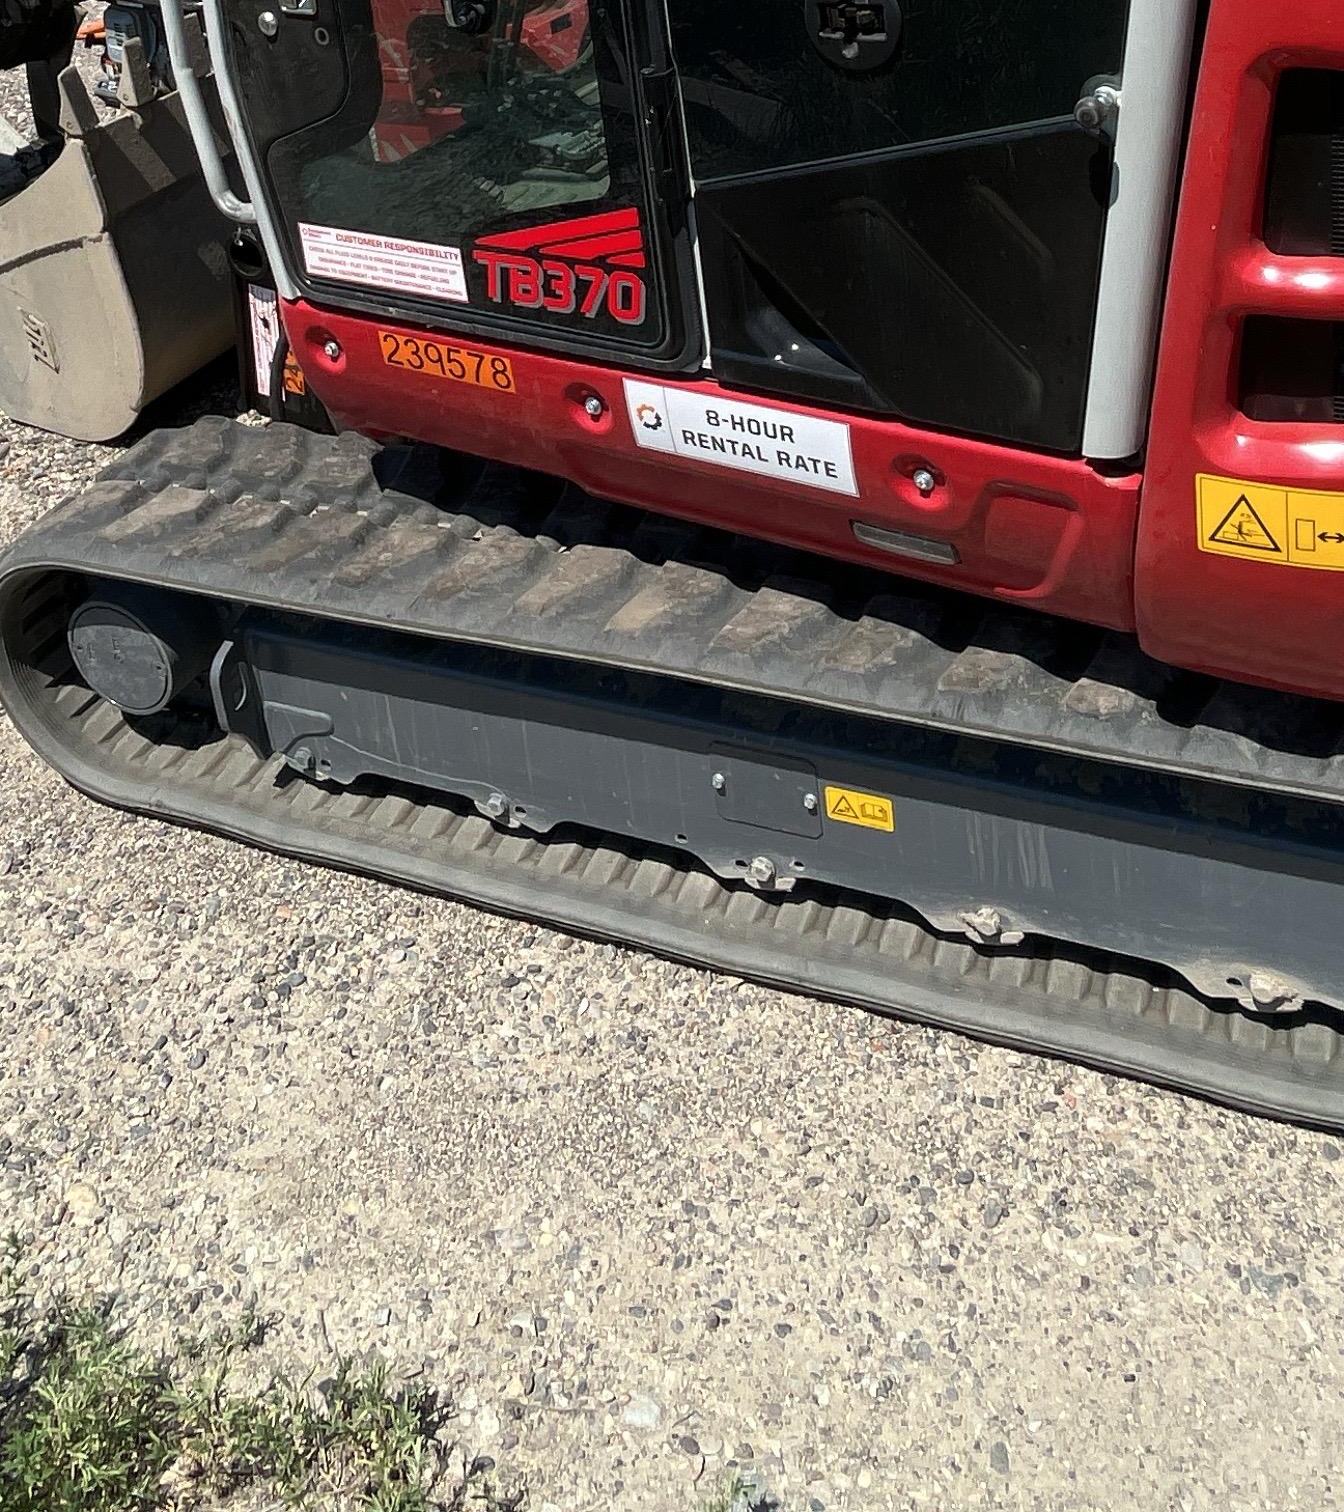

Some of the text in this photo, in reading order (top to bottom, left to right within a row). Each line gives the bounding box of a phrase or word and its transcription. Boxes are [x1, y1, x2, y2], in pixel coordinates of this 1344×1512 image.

[384, 241, 459, 260] RESPONSIBILITY
[473, 250, 646, 325] TB370
[383, 333, 512, 390] 239578
[706, 410, 795, 444] 8-HOUR
[682, 430, 839, 479] RENTAL RATE
